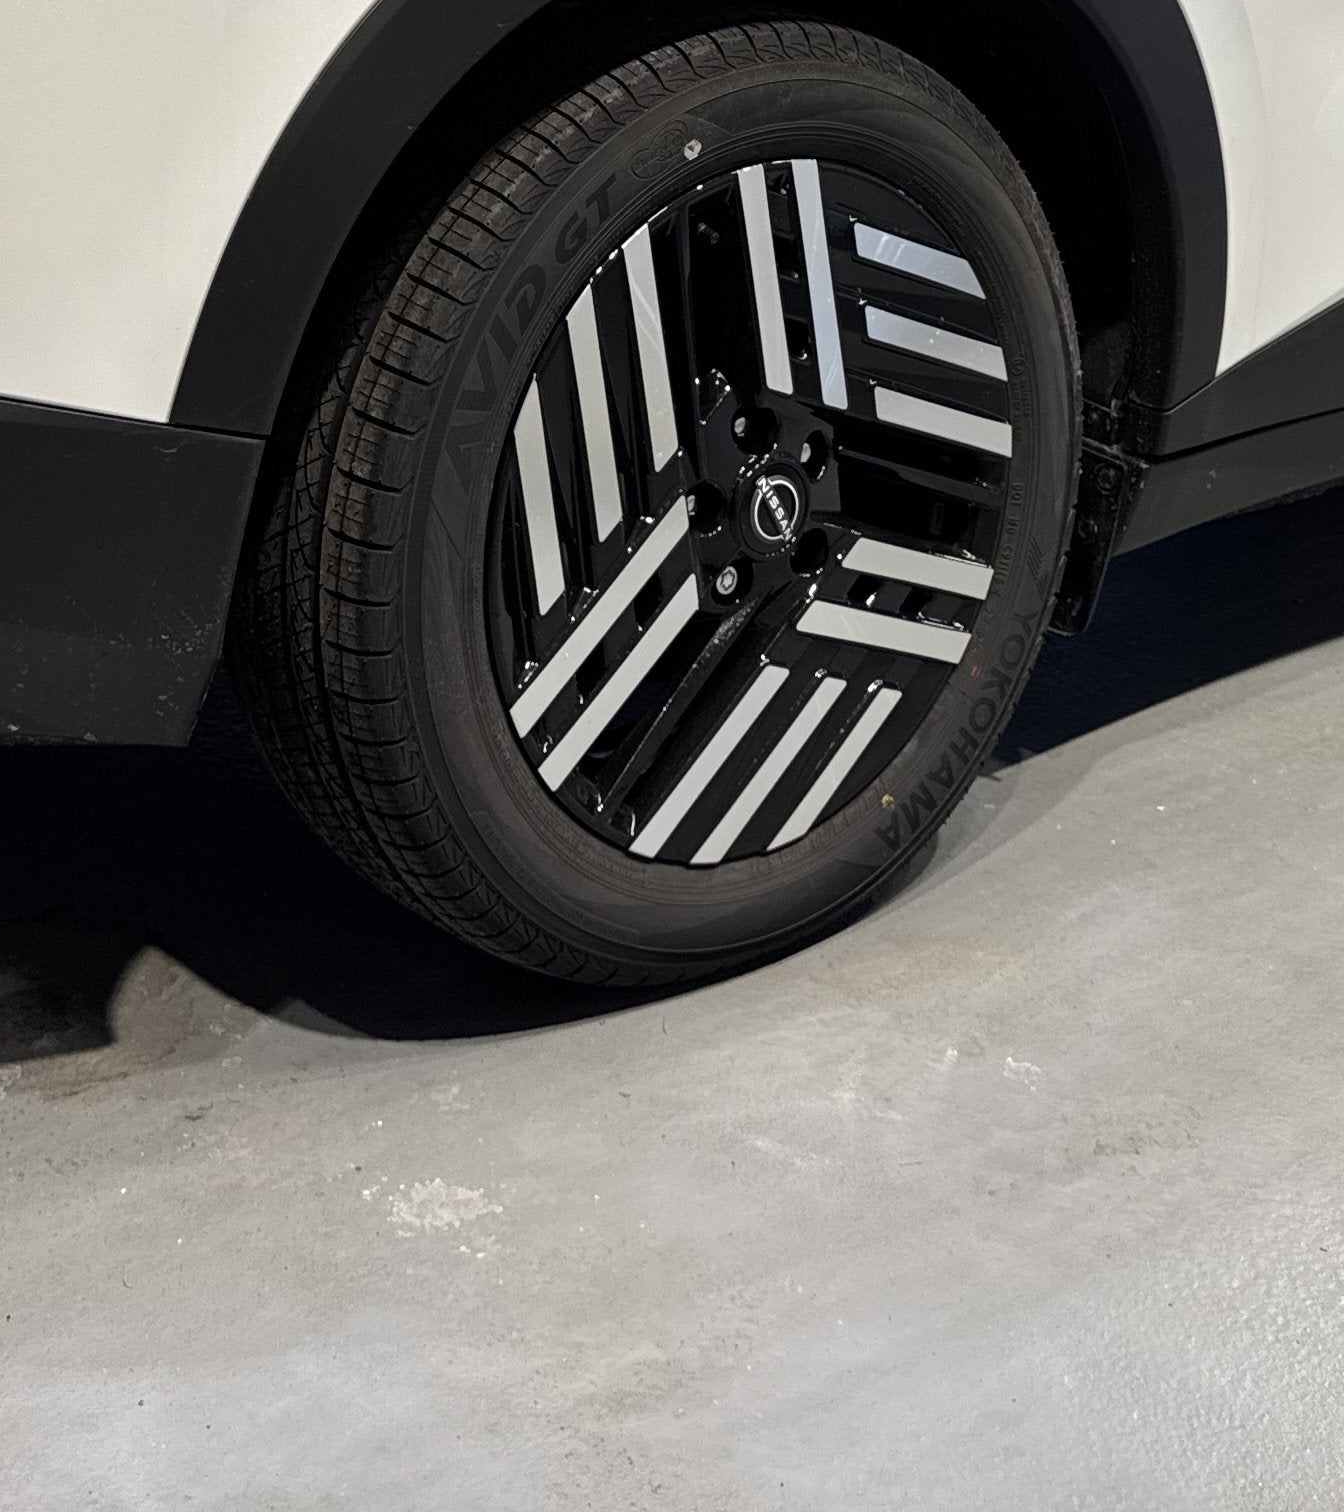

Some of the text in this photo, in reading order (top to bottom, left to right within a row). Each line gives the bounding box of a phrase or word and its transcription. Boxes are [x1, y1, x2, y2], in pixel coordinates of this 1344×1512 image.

[443, 173, 617, 496] AVID GT
[758, 477, 792, 542] NISSAN
[874, 610, 1040, 851] YOKOHAMA
